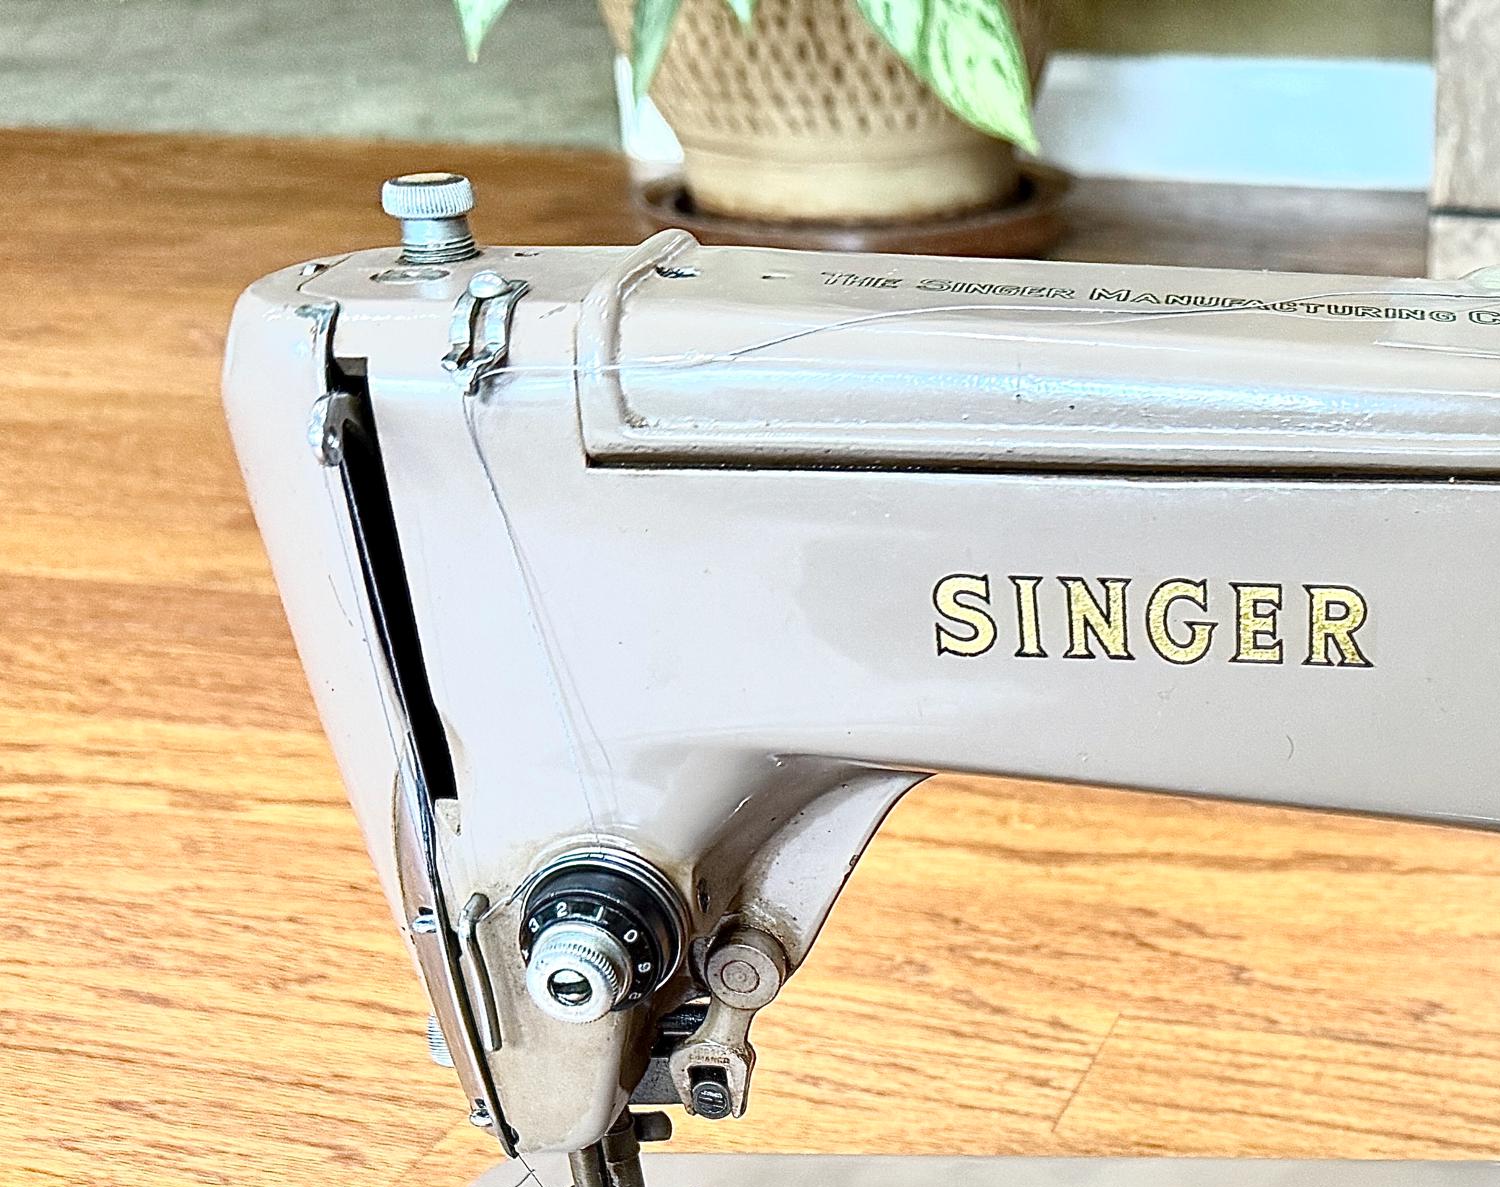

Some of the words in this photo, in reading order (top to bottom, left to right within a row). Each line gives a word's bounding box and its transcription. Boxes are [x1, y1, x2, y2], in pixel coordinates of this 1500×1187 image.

[820, 271, 902, 290] THE
[916, 278, 1076, 300] SINGER
[1089, 287, 1457, 323] MANUFACTURING
[932, 573, 1374, 667] SINGER
[556, 901, 568, 918] 2
[623, 929, 638, 943] 0
